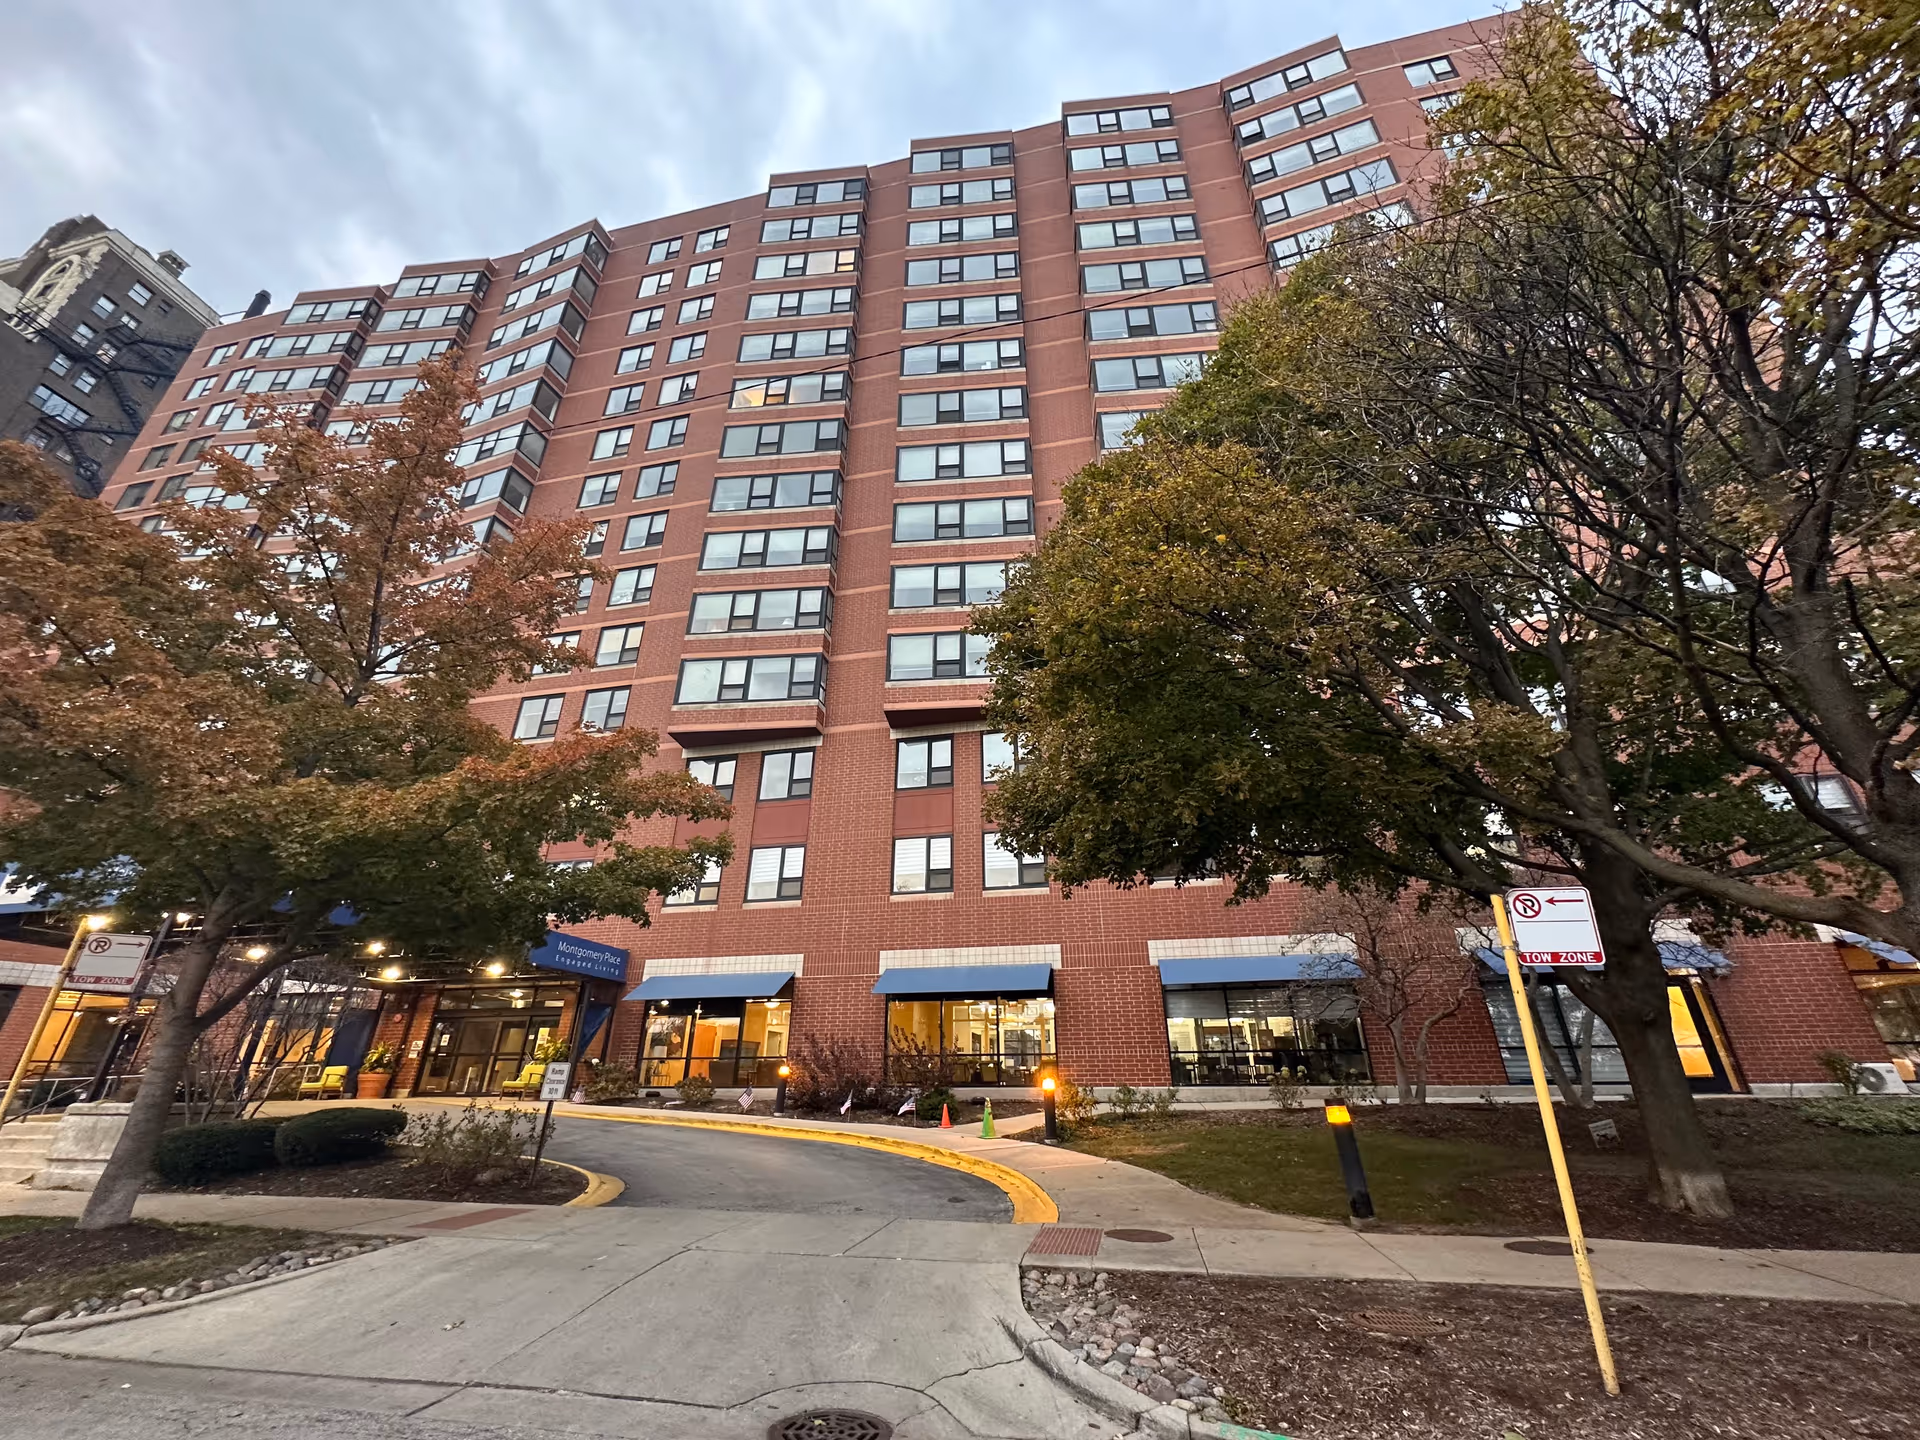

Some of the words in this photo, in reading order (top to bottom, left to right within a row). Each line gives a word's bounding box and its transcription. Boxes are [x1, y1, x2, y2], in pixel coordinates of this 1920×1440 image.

[558, 941, 604, 962] Montgomery
[604, 952, 621, 965] Place
[1523, 952, 1552, 963] TOW
[1558, 952, 1597, 963] ZONE
[555, 954, 592, 968] Engaged
[595, 965, 619, 975] Living
